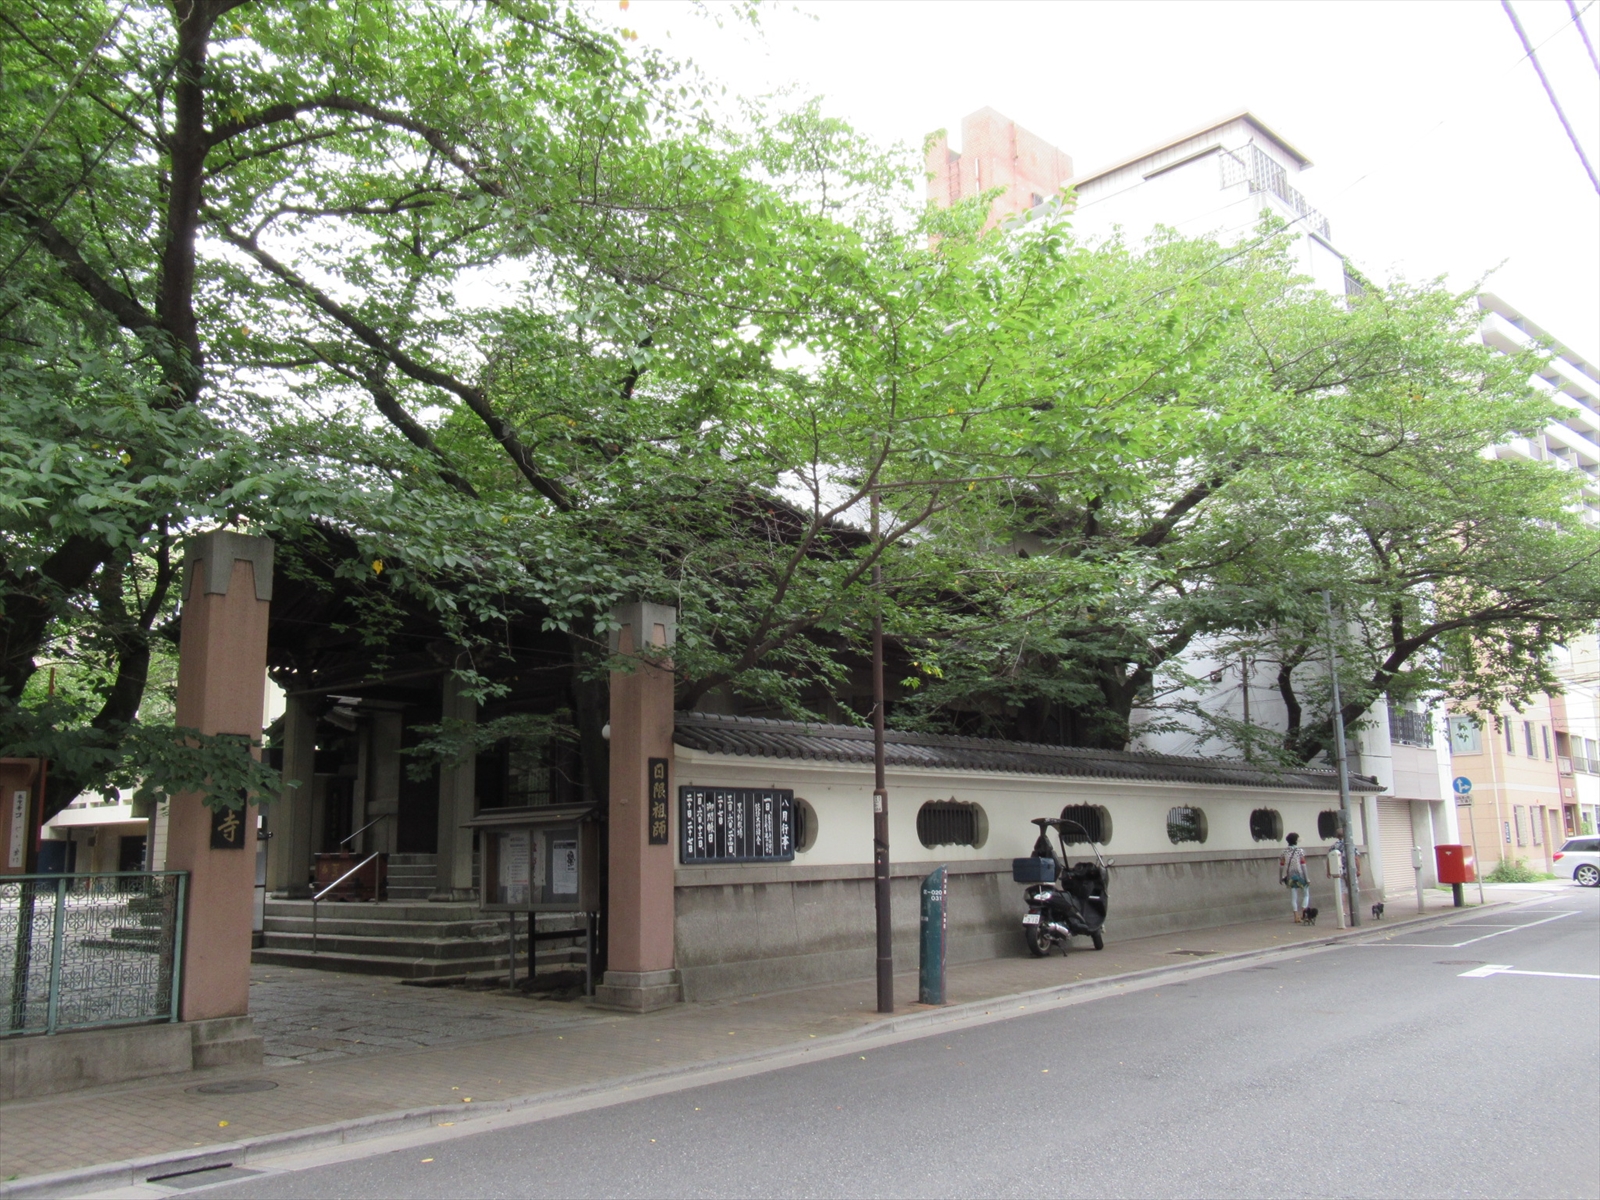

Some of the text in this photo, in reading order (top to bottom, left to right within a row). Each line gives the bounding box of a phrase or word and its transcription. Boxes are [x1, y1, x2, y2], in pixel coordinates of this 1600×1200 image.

[217, 809, 240, 842] 寺
[653, 763, 666, 838] 日限祖師
